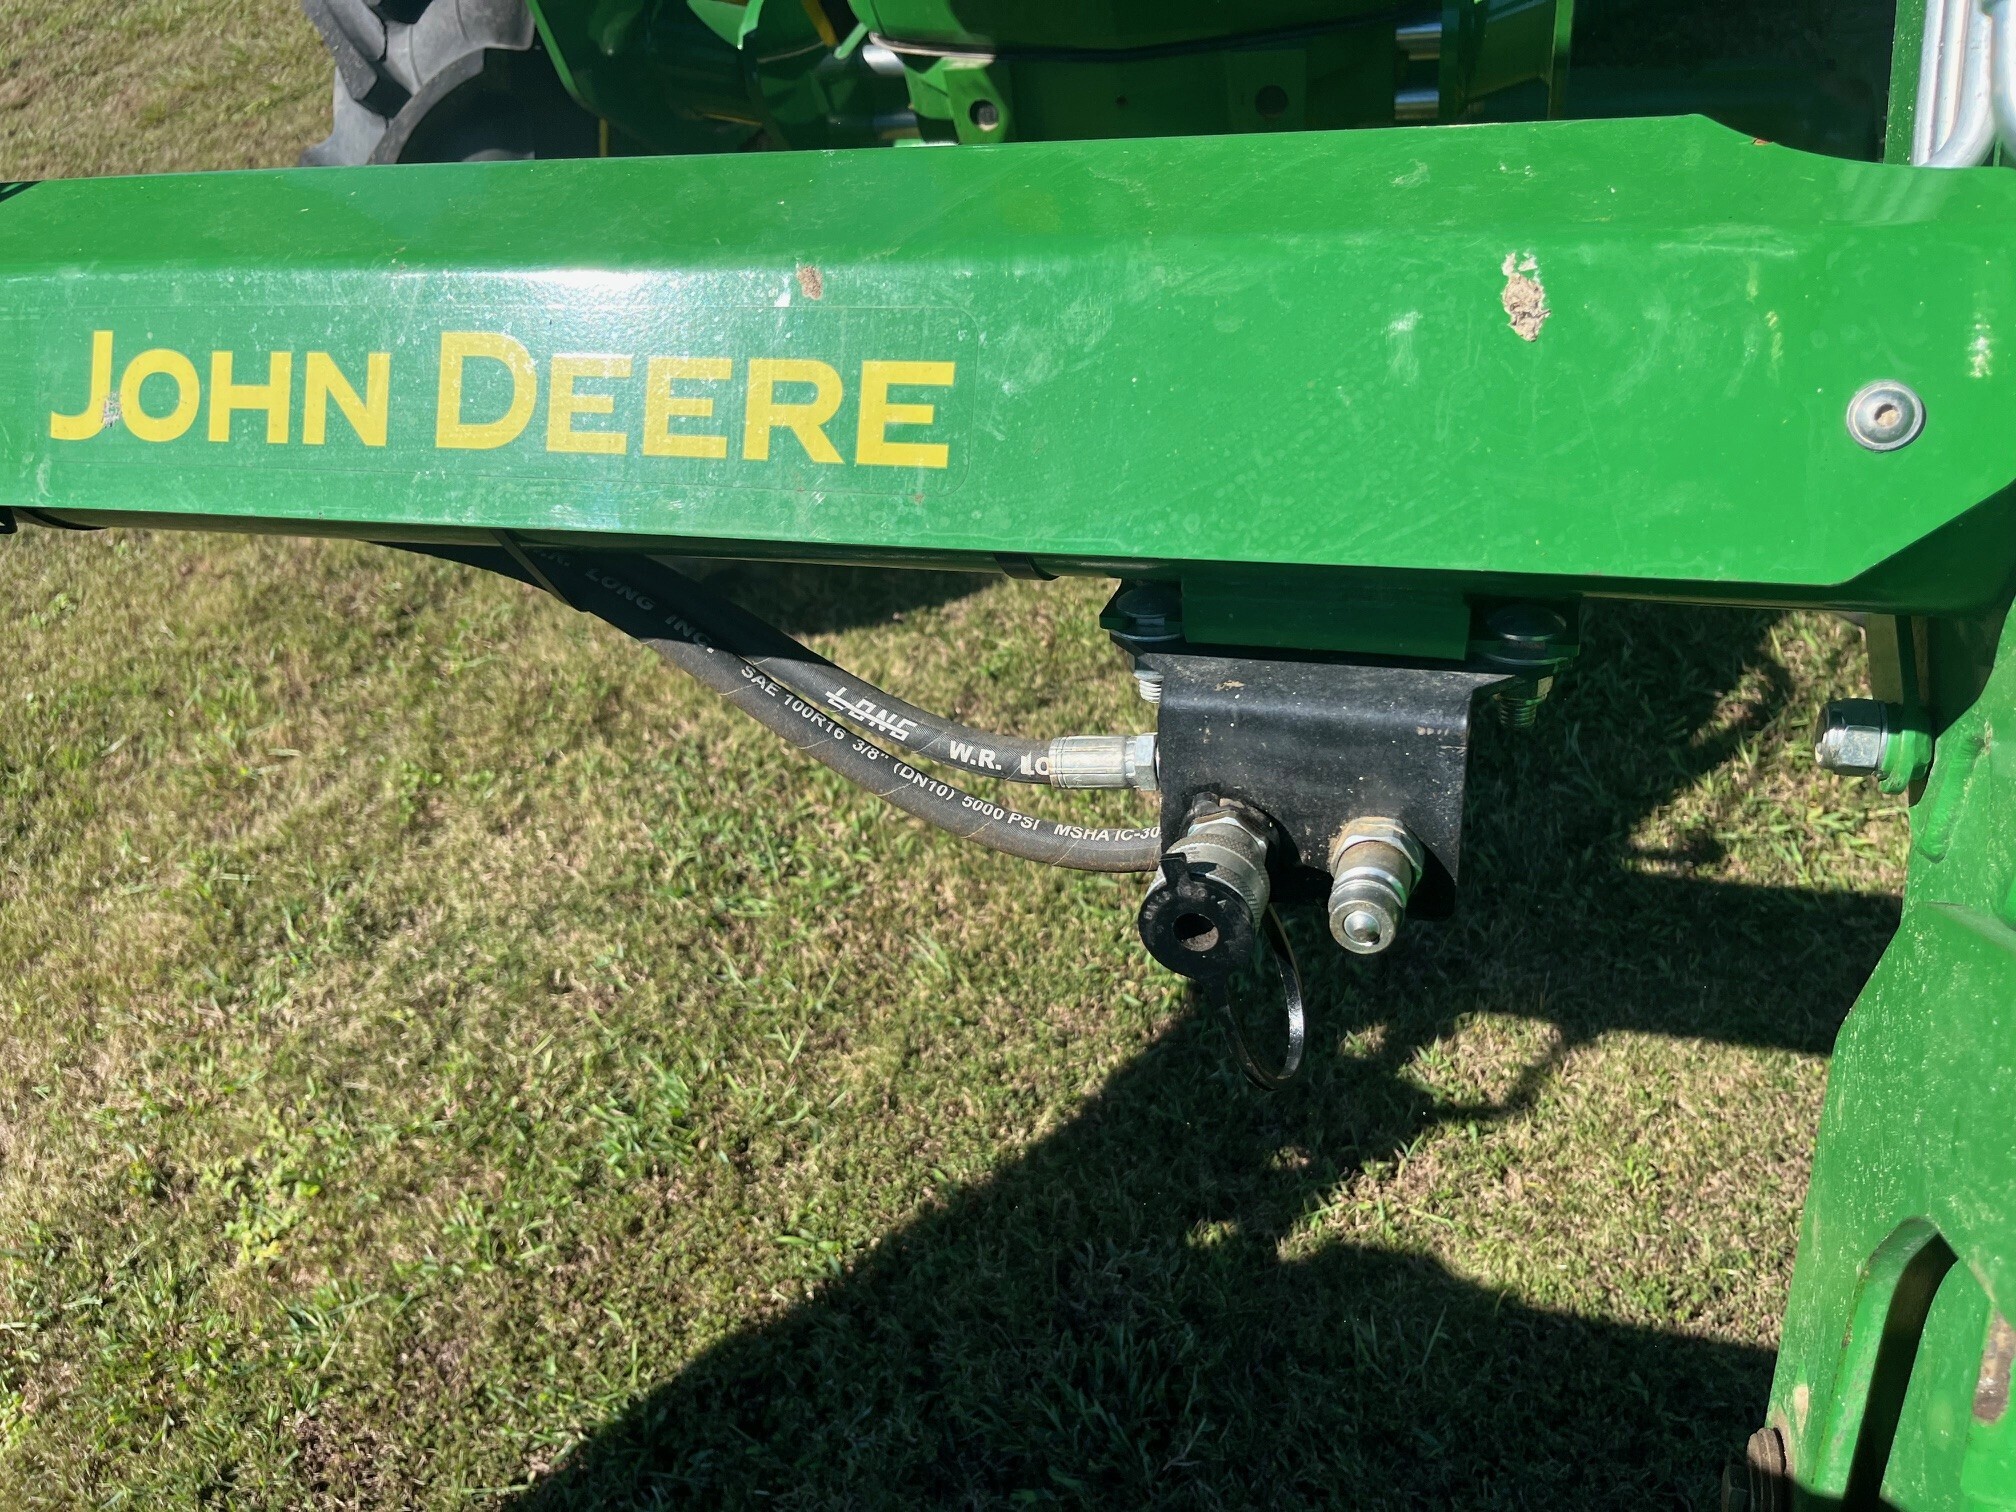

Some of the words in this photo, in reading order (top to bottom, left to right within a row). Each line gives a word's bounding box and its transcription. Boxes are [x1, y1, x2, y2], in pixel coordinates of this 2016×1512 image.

[50, 329, 391, 447] JOHN
[434, 330, 956, 469] DEERE
[585, 568, 657, 611] LONG
[665, 613, 716, 654] INC.
[741, 663, 782, 698] SAE
[783, 692, 847, 741] 100R16
[892, 761, 956, 802] (DN10)
[961, 795, 1005, 822] 5000
[1007, 812, 1041, 832] PSI
[1054, 824, 1110, 842] MSHA
[825, 686, 920, 743] LONG
[948, 740, 1003, 772] W.R.
